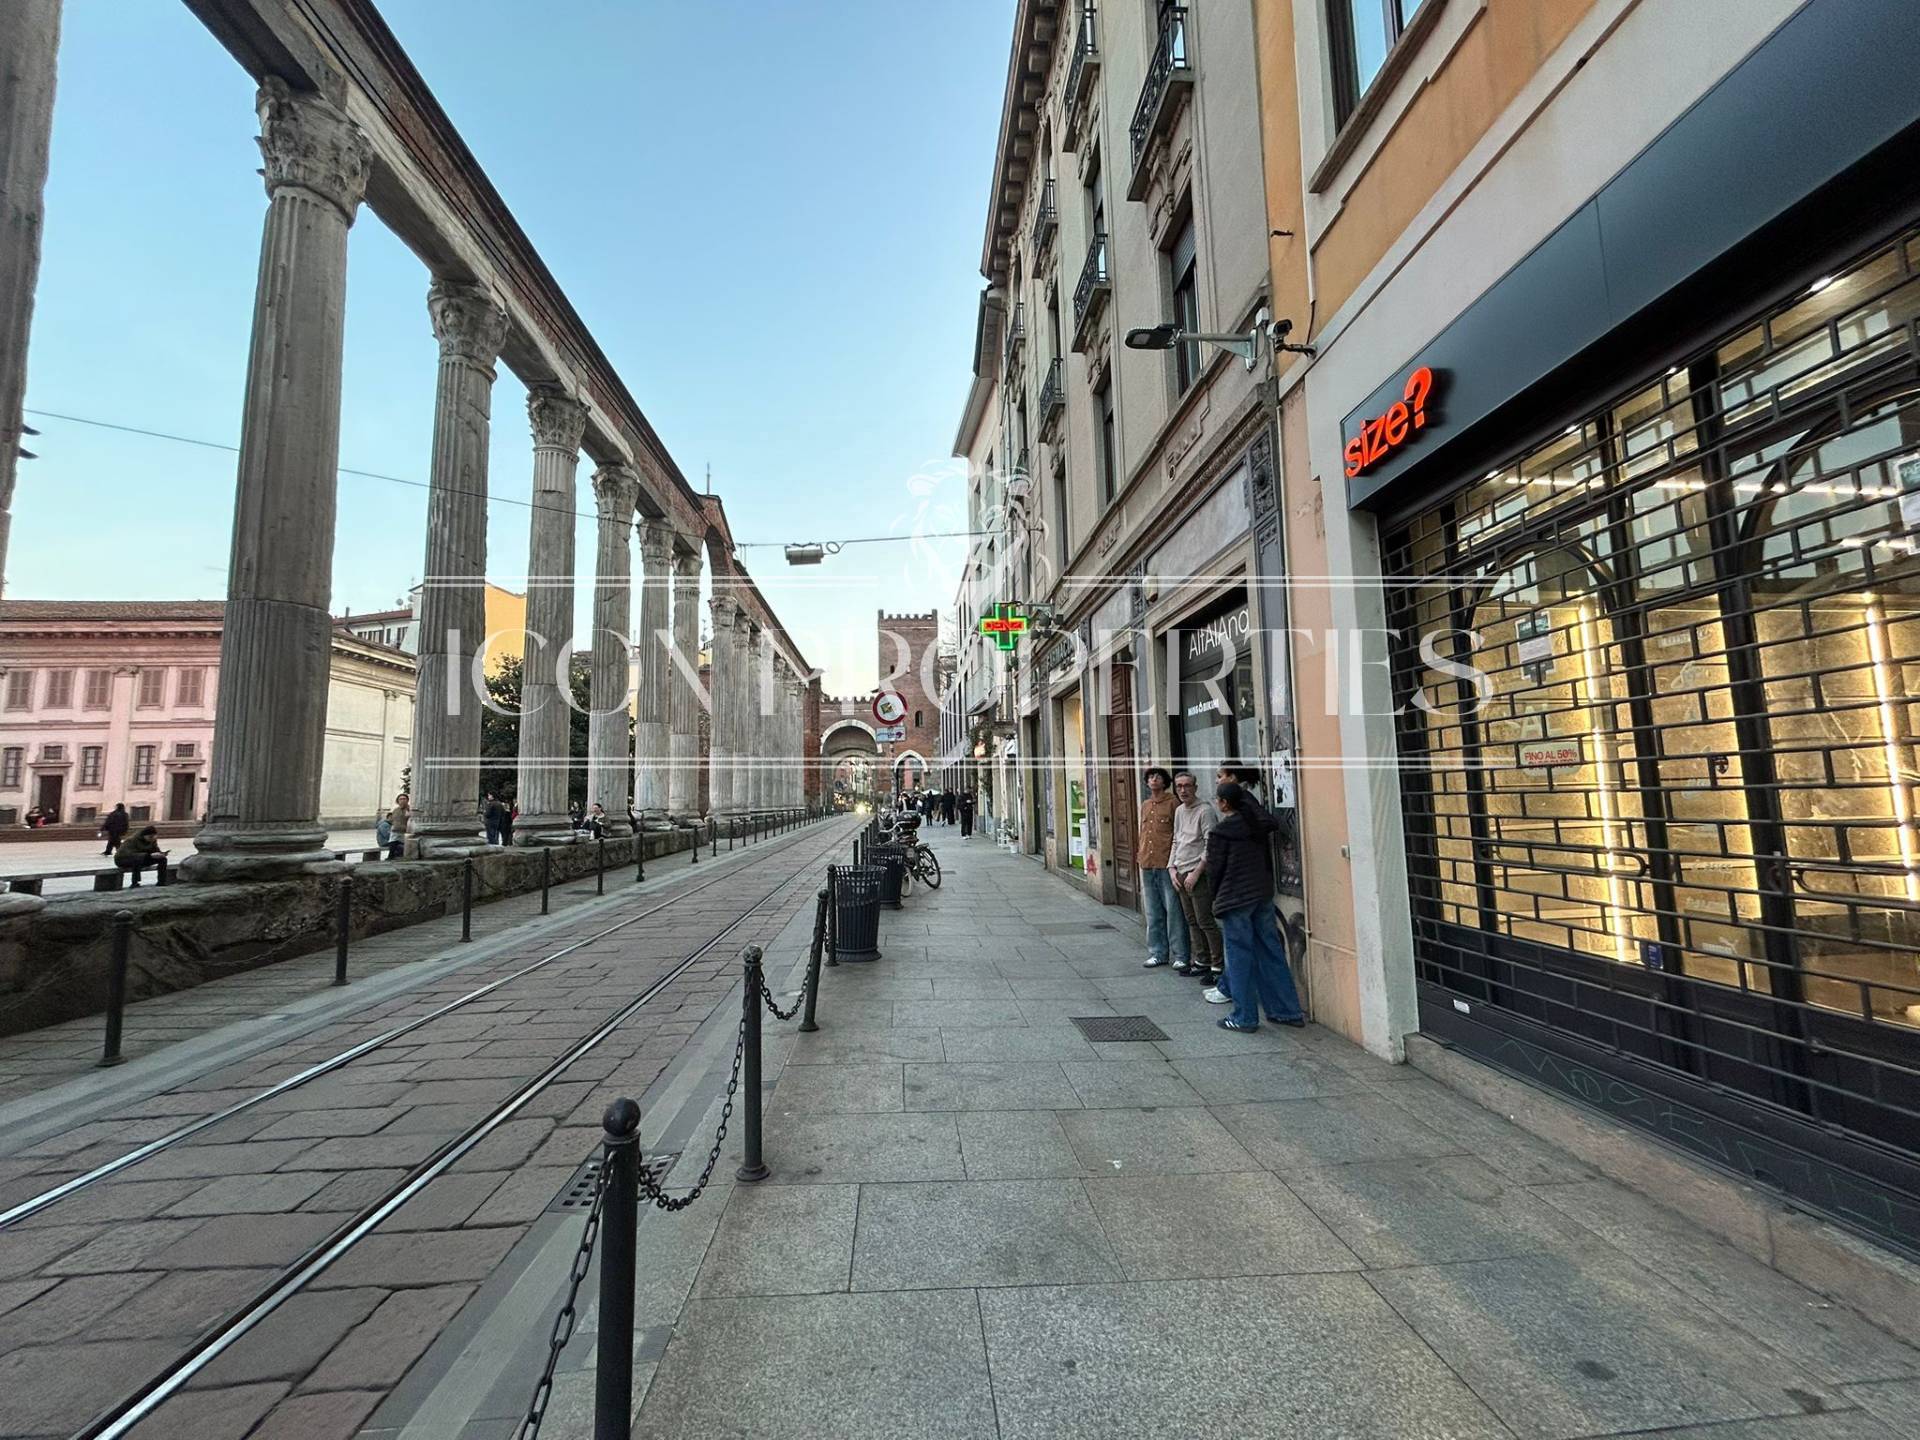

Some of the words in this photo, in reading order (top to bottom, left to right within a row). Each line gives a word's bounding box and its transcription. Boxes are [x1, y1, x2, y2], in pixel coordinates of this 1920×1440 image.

[1344, 366, 1433, 477] size?
[1524, 751, 1544, 761] FINO
[1545, 750, 1556, 760] AL
[1557, 748, 1577, 759] 50%
